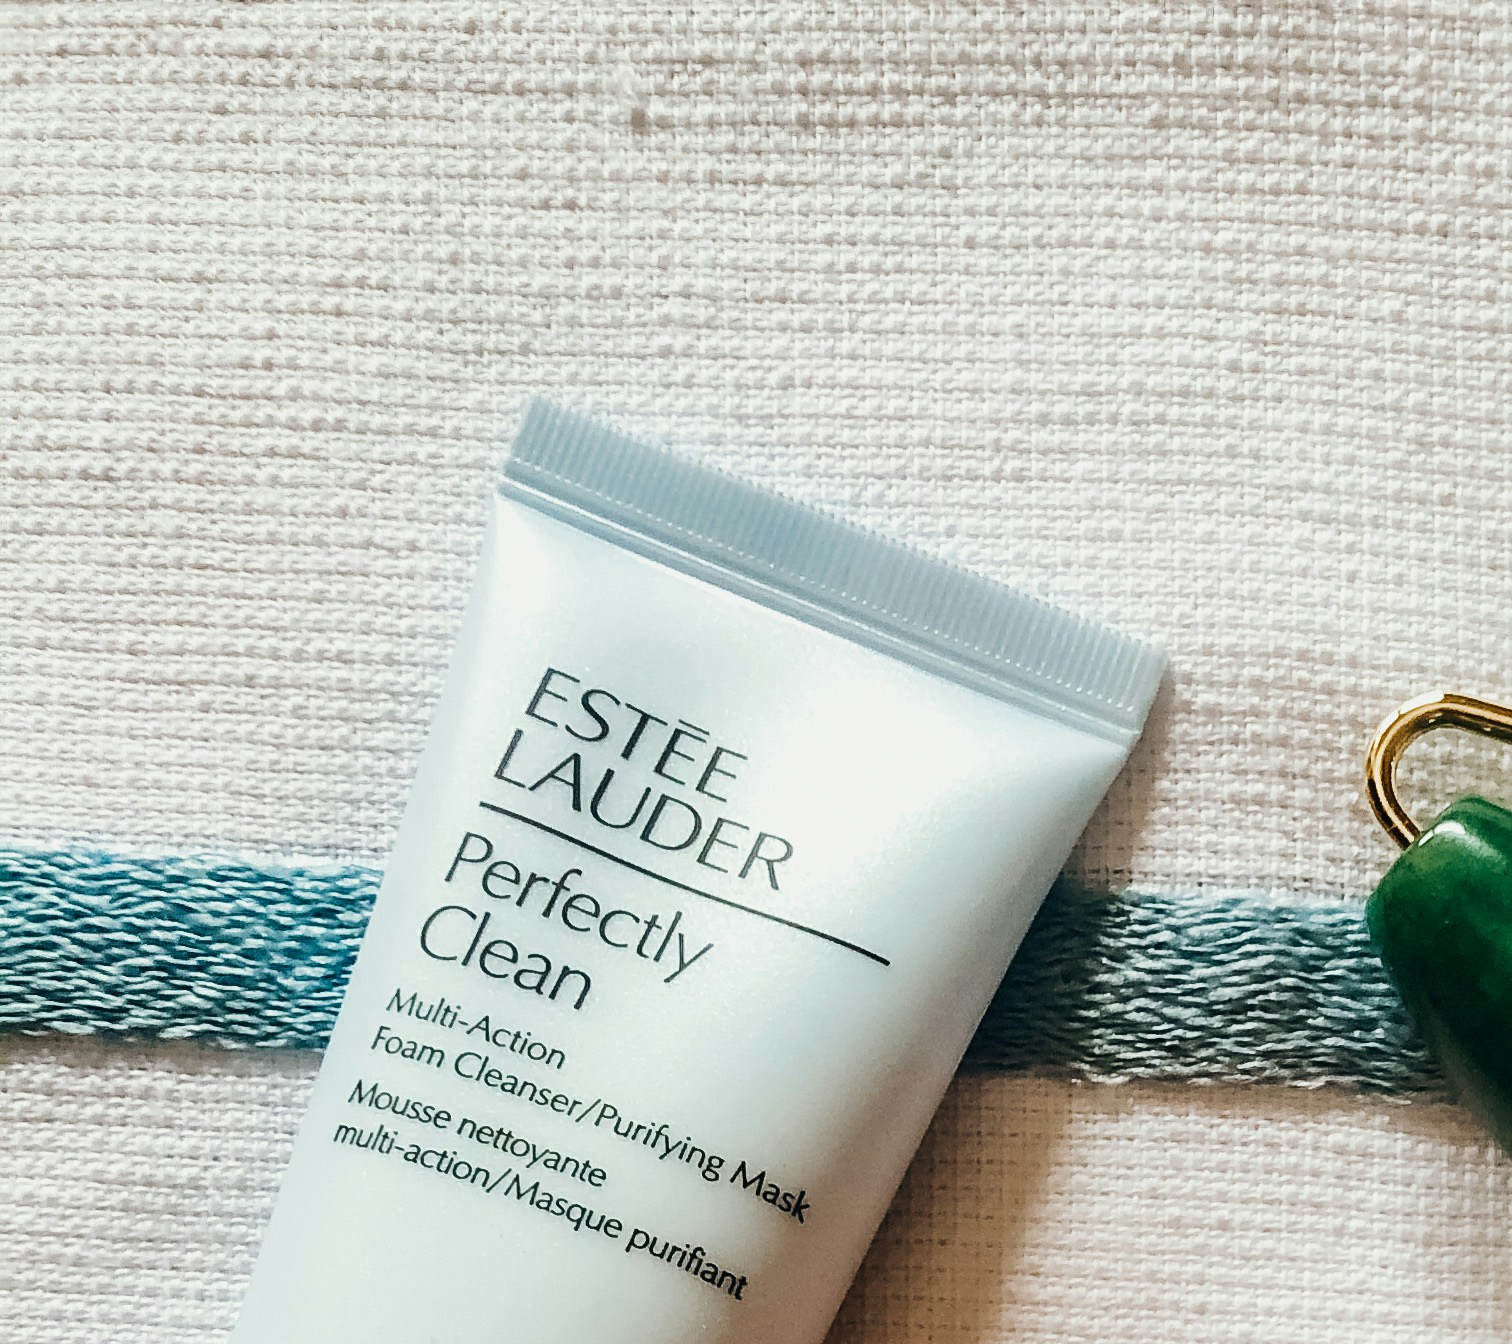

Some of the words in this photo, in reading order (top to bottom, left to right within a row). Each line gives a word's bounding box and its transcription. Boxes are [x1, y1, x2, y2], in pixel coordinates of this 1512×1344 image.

[494, 729, 795, 891] LAUDER
[419, 904, 593, 1011] Clean
[445, 831, 714, 983] Perfectly
[386, 988, 566, 1069] Multi-Action
[348, 1080, 452, 1130] Mousse
[457, 1114, 608, 1189] nettoyante
[371, 1025, 445, 1069] Foam
[454, 1050, 726, 1182] Cleanser/Purifying
[730, 1160, 813, 1223] Mask
[334, 1121, 624, 1239] multi-action/Masque
[626, 1229, 749, 1301] purifiant
